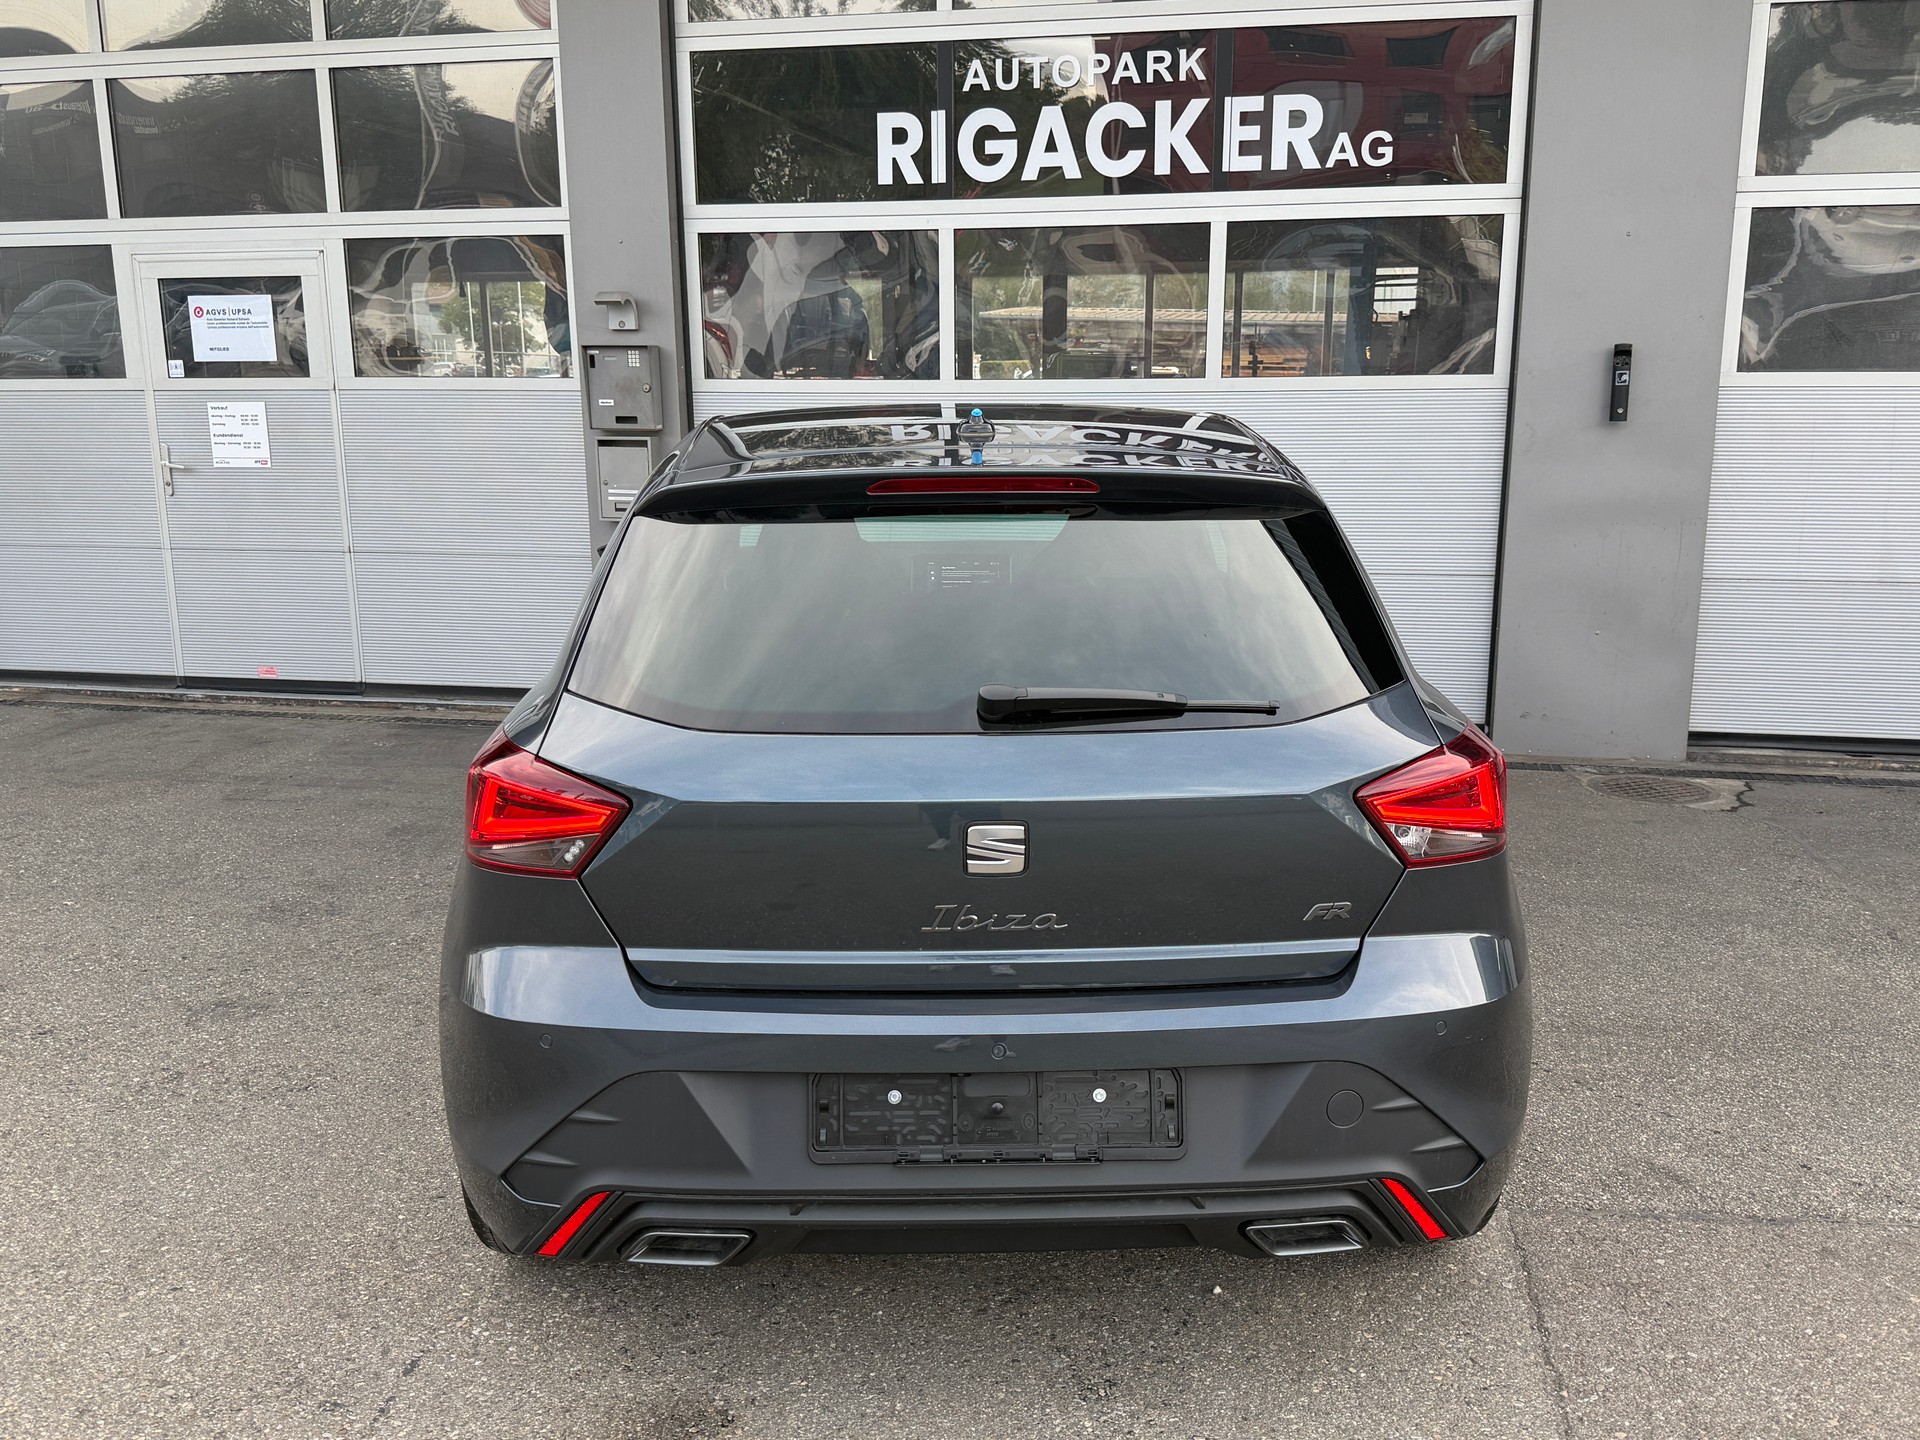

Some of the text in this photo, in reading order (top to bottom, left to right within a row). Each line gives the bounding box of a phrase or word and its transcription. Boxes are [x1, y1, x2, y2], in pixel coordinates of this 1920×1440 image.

[962, 47, 1207, 92] AUTOPARK
[876, 93, 1394, 185] RIGACKER AG
[920, 904, 1068, 934] Ibiza
[1303, 901, 1352, 922] FR
